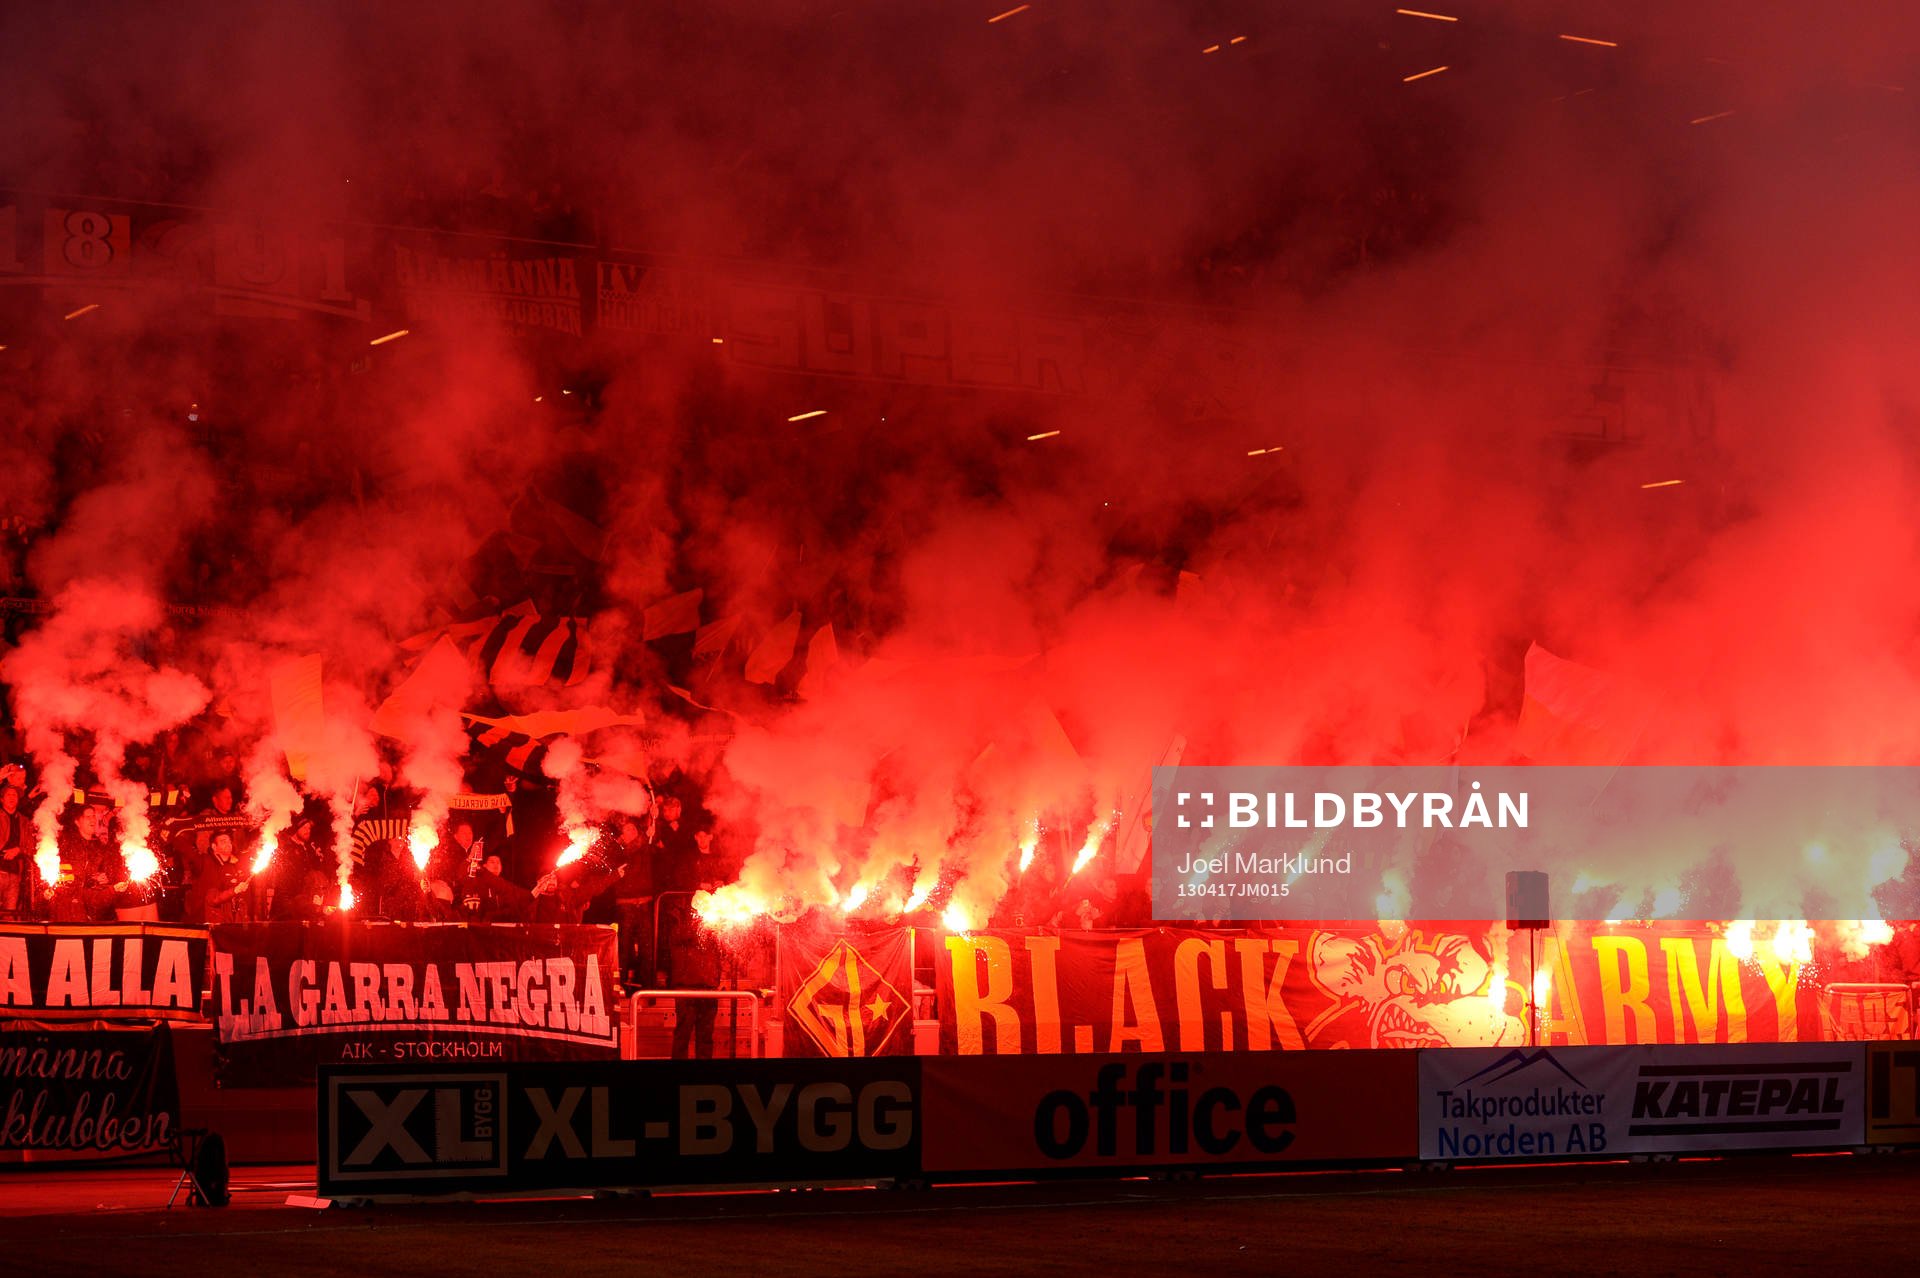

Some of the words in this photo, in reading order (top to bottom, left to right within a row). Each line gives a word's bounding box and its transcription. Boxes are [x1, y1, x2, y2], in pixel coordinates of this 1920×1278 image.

[44, 937, 194, 1008] ALLA
[215, 951, 283, 1033] LA
[288, 958, 450, 1027] GARRA
[455, 953, 611, 1037] NEGRA
[945, 935, 1305, 1056] BLACK
[1536, 935, 1813, 1046] ARMY
[341, 1042, 373, 1060] AIK
[394, 1040, 503, 1059] STOCKHOLM
[342, 1087, 494, 1166] XL
[473, 1086, 494, 1139] BYGG
[523, 1080, 914, 1159] XL-BYGG
[1034, 1062, 1297, 1160] office
[1436, 1085, 1606, 1124] Takprodukter
[1631, 1077, 1846, 1119] KATEPAL
[1437, 1124, 1556, 1157] Norden
[1565, 1122, 1608, 1153] AB
